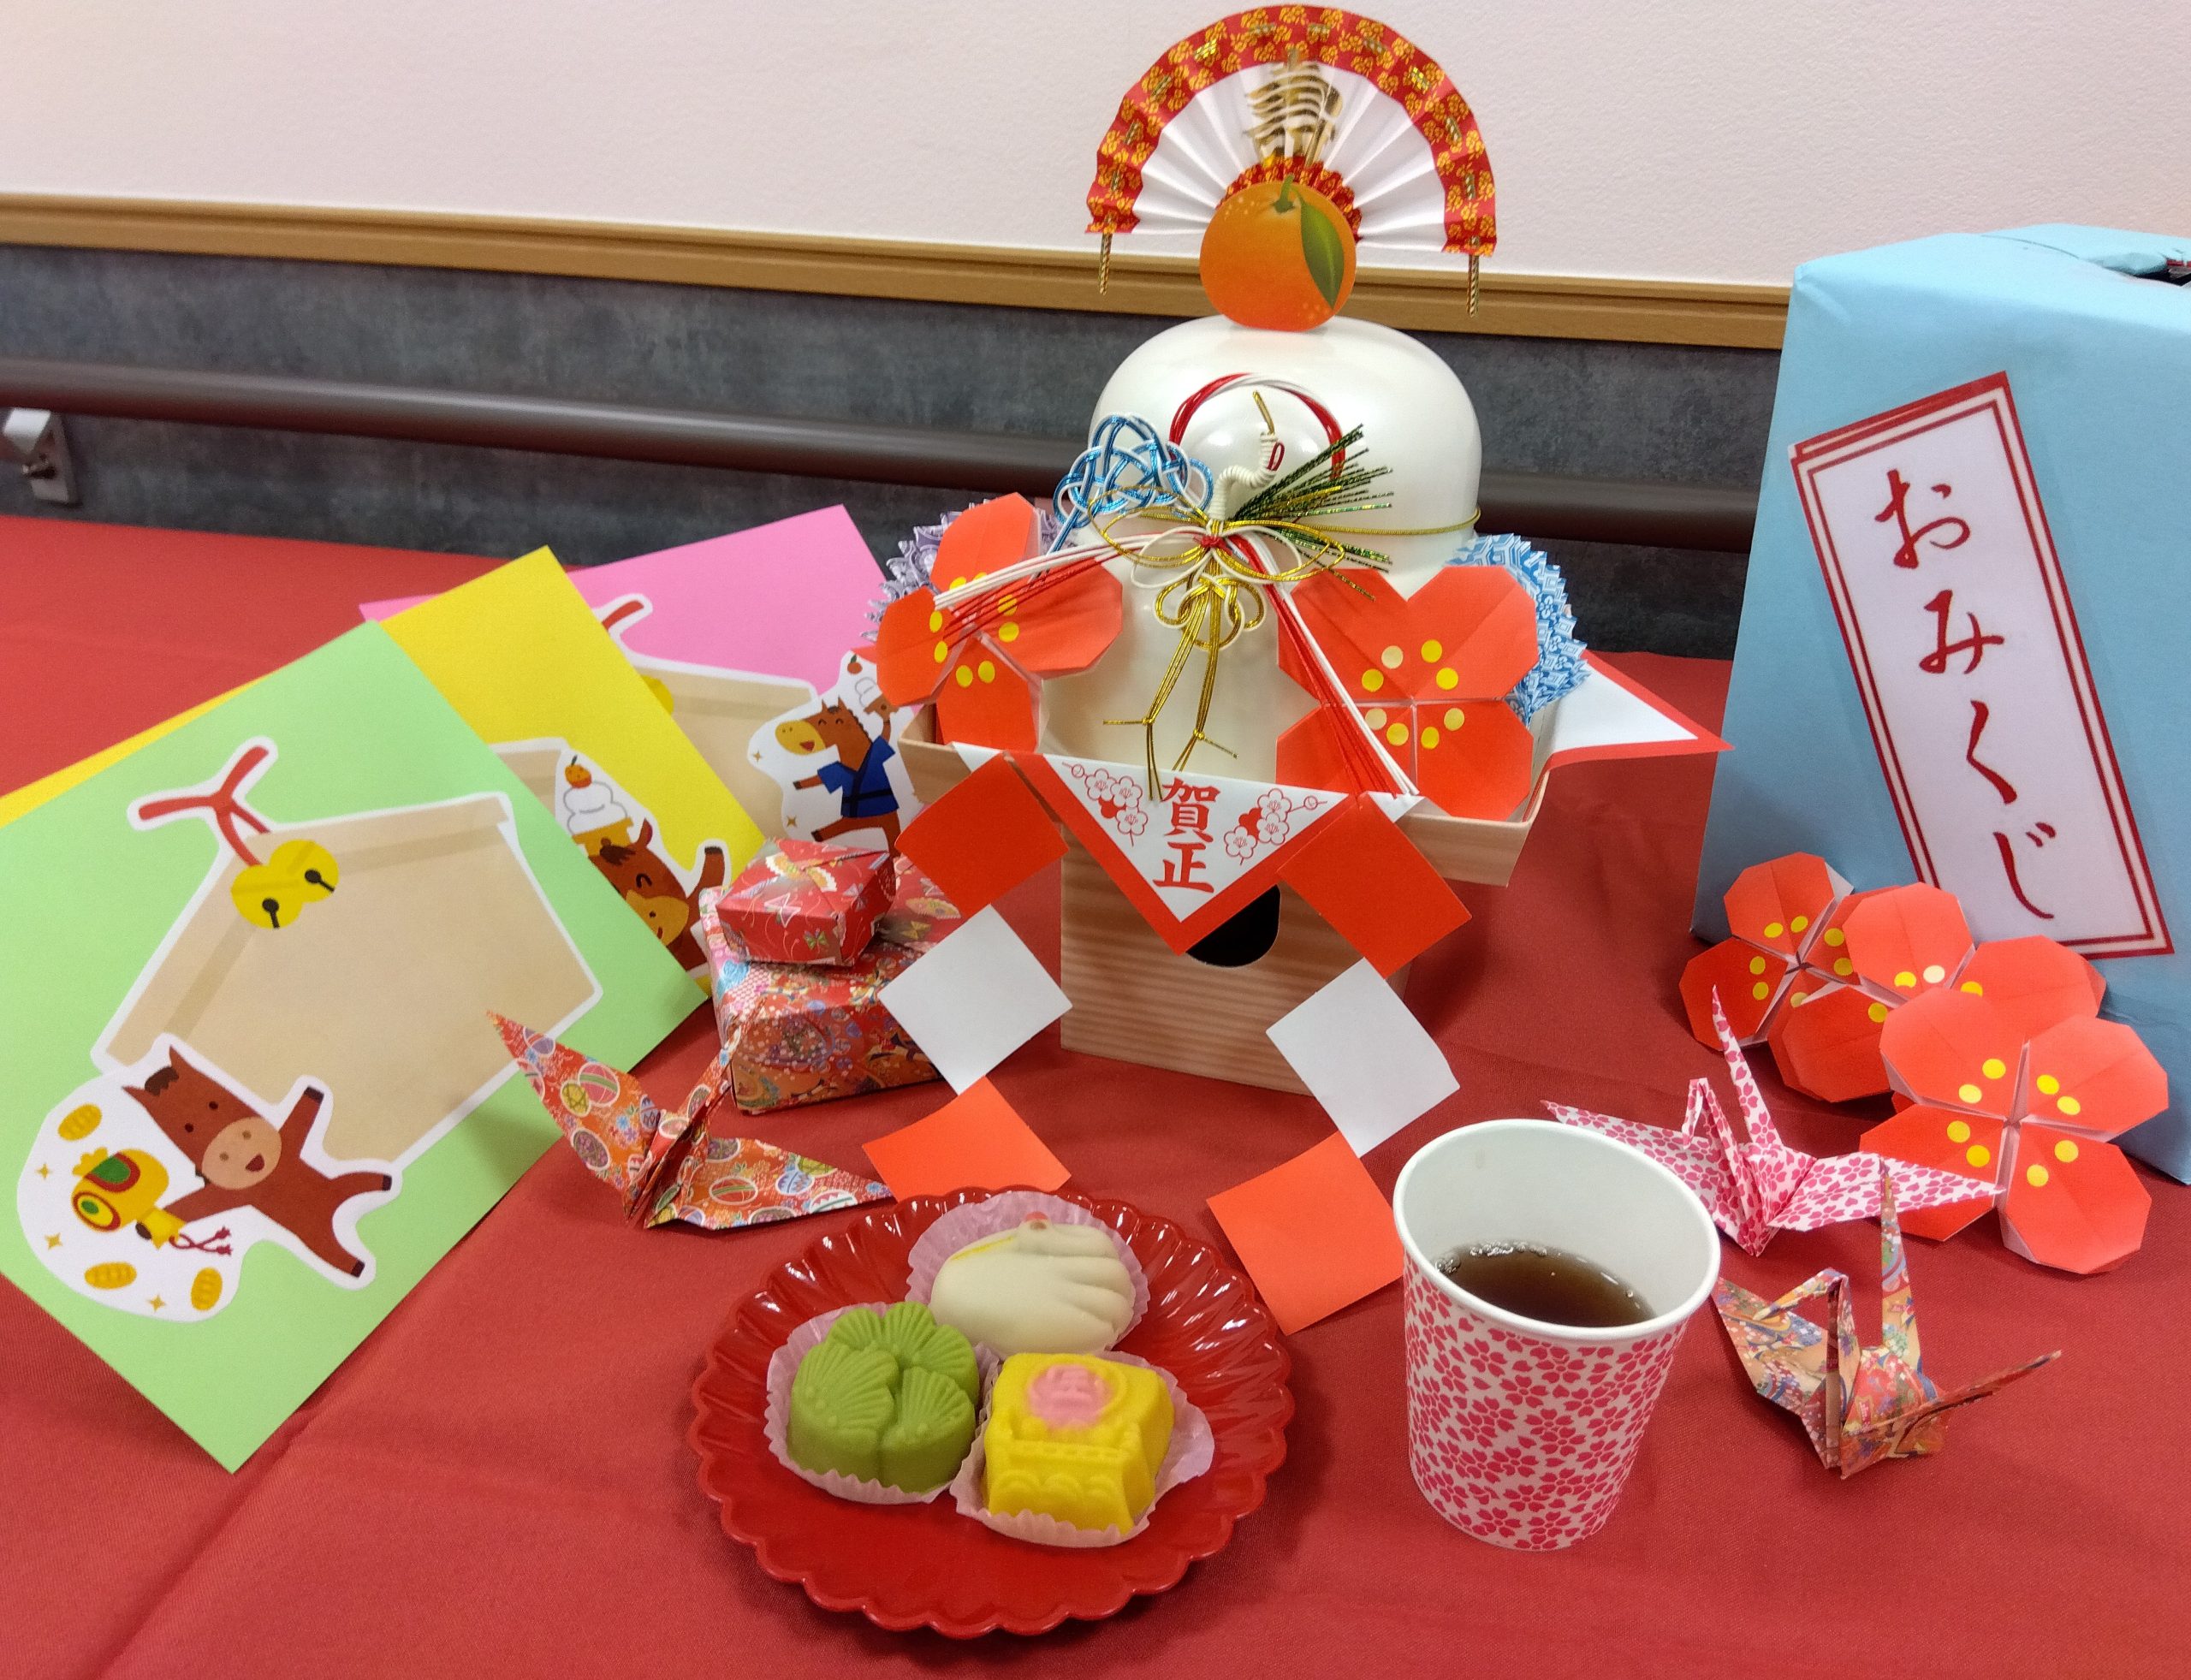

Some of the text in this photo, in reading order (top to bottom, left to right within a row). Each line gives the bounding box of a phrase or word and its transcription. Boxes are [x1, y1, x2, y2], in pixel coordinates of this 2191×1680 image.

[1153, 777, 1220, 893] 賀正
[1875, 469, 2056, 919] おみくじ
